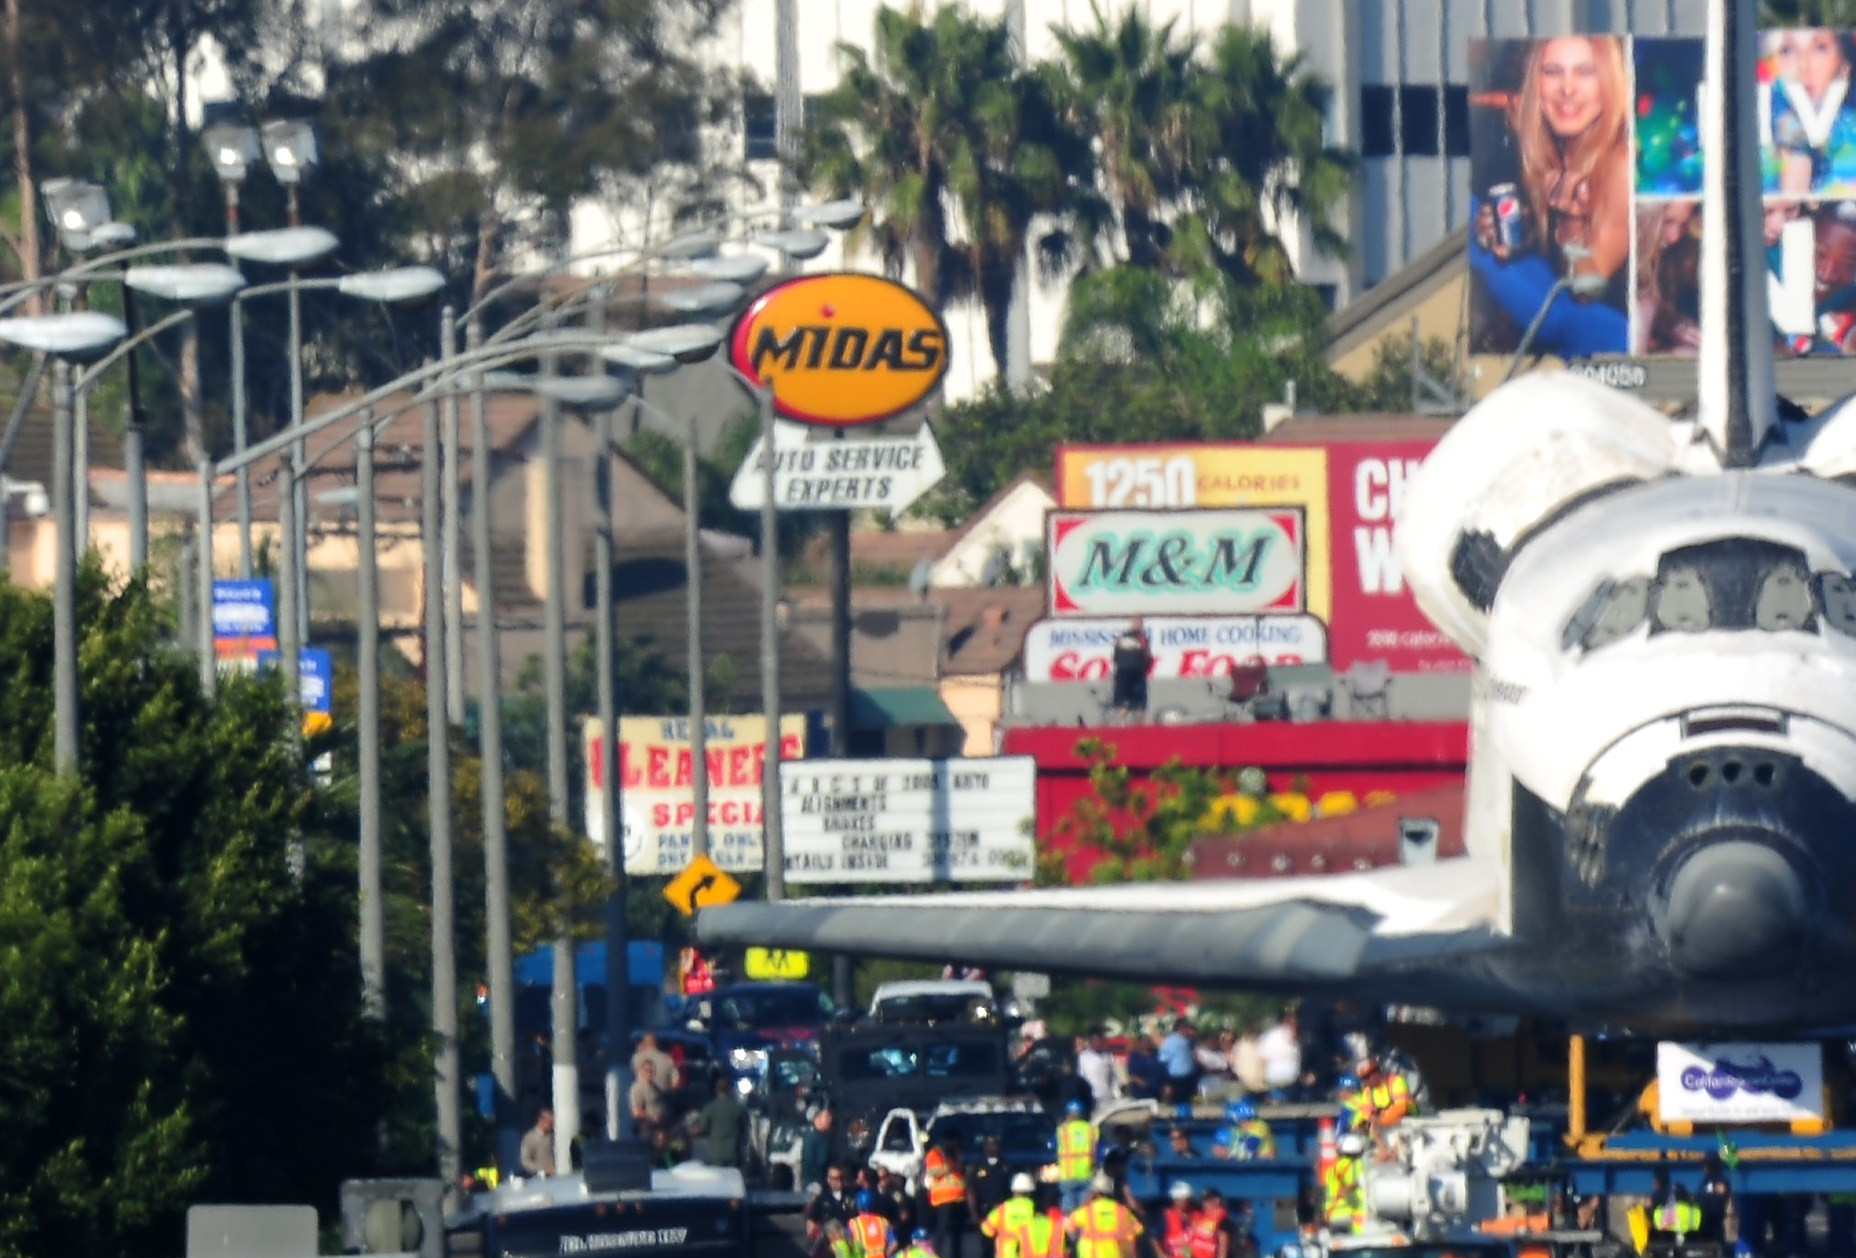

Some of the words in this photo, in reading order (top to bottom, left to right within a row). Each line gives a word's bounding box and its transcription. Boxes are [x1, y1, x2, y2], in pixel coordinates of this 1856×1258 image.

[750, 325, 940, 372] MIDAS
[825, 446, 924, 471] SERVICE
[787, 476, 892, 500] EXPERTS
[1084, 453, 1197, 508] 1250
[1197, 473, 1301, 492] CALORIES
[1077, 535, 1273, 589] M&M
[1161, 624, 1209, 646] HOME
[1216, 622, 1302, 646] COOKING
